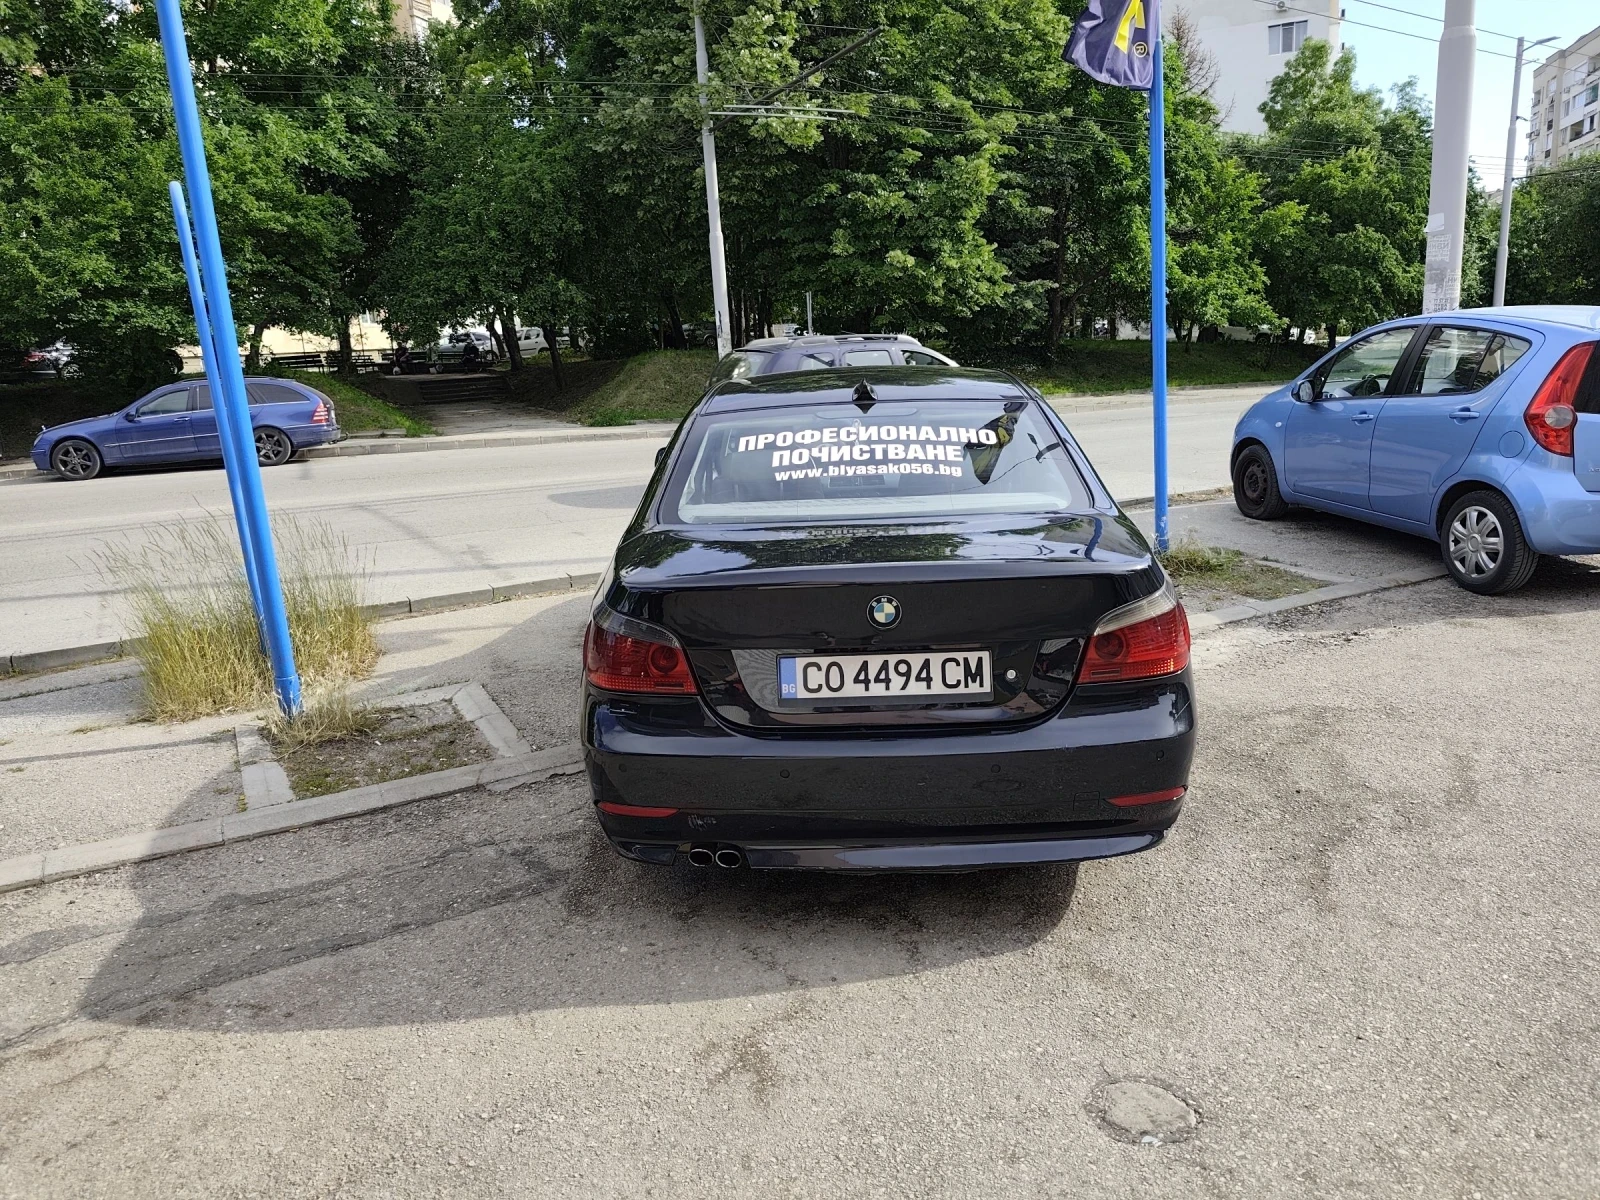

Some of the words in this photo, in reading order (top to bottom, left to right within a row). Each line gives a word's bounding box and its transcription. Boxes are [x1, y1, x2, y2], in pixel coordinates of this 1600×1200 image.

[738, 425, 998, 452] ПРОФЕСИОНАЛНО
[771, 443, 964, 467] ПОЧИСТВАНЕ
[774, 463, 963, 481] www.blyasak056.bg
[853, 658, 934, 691] 4494
[782, 683, 796, 694] BG
